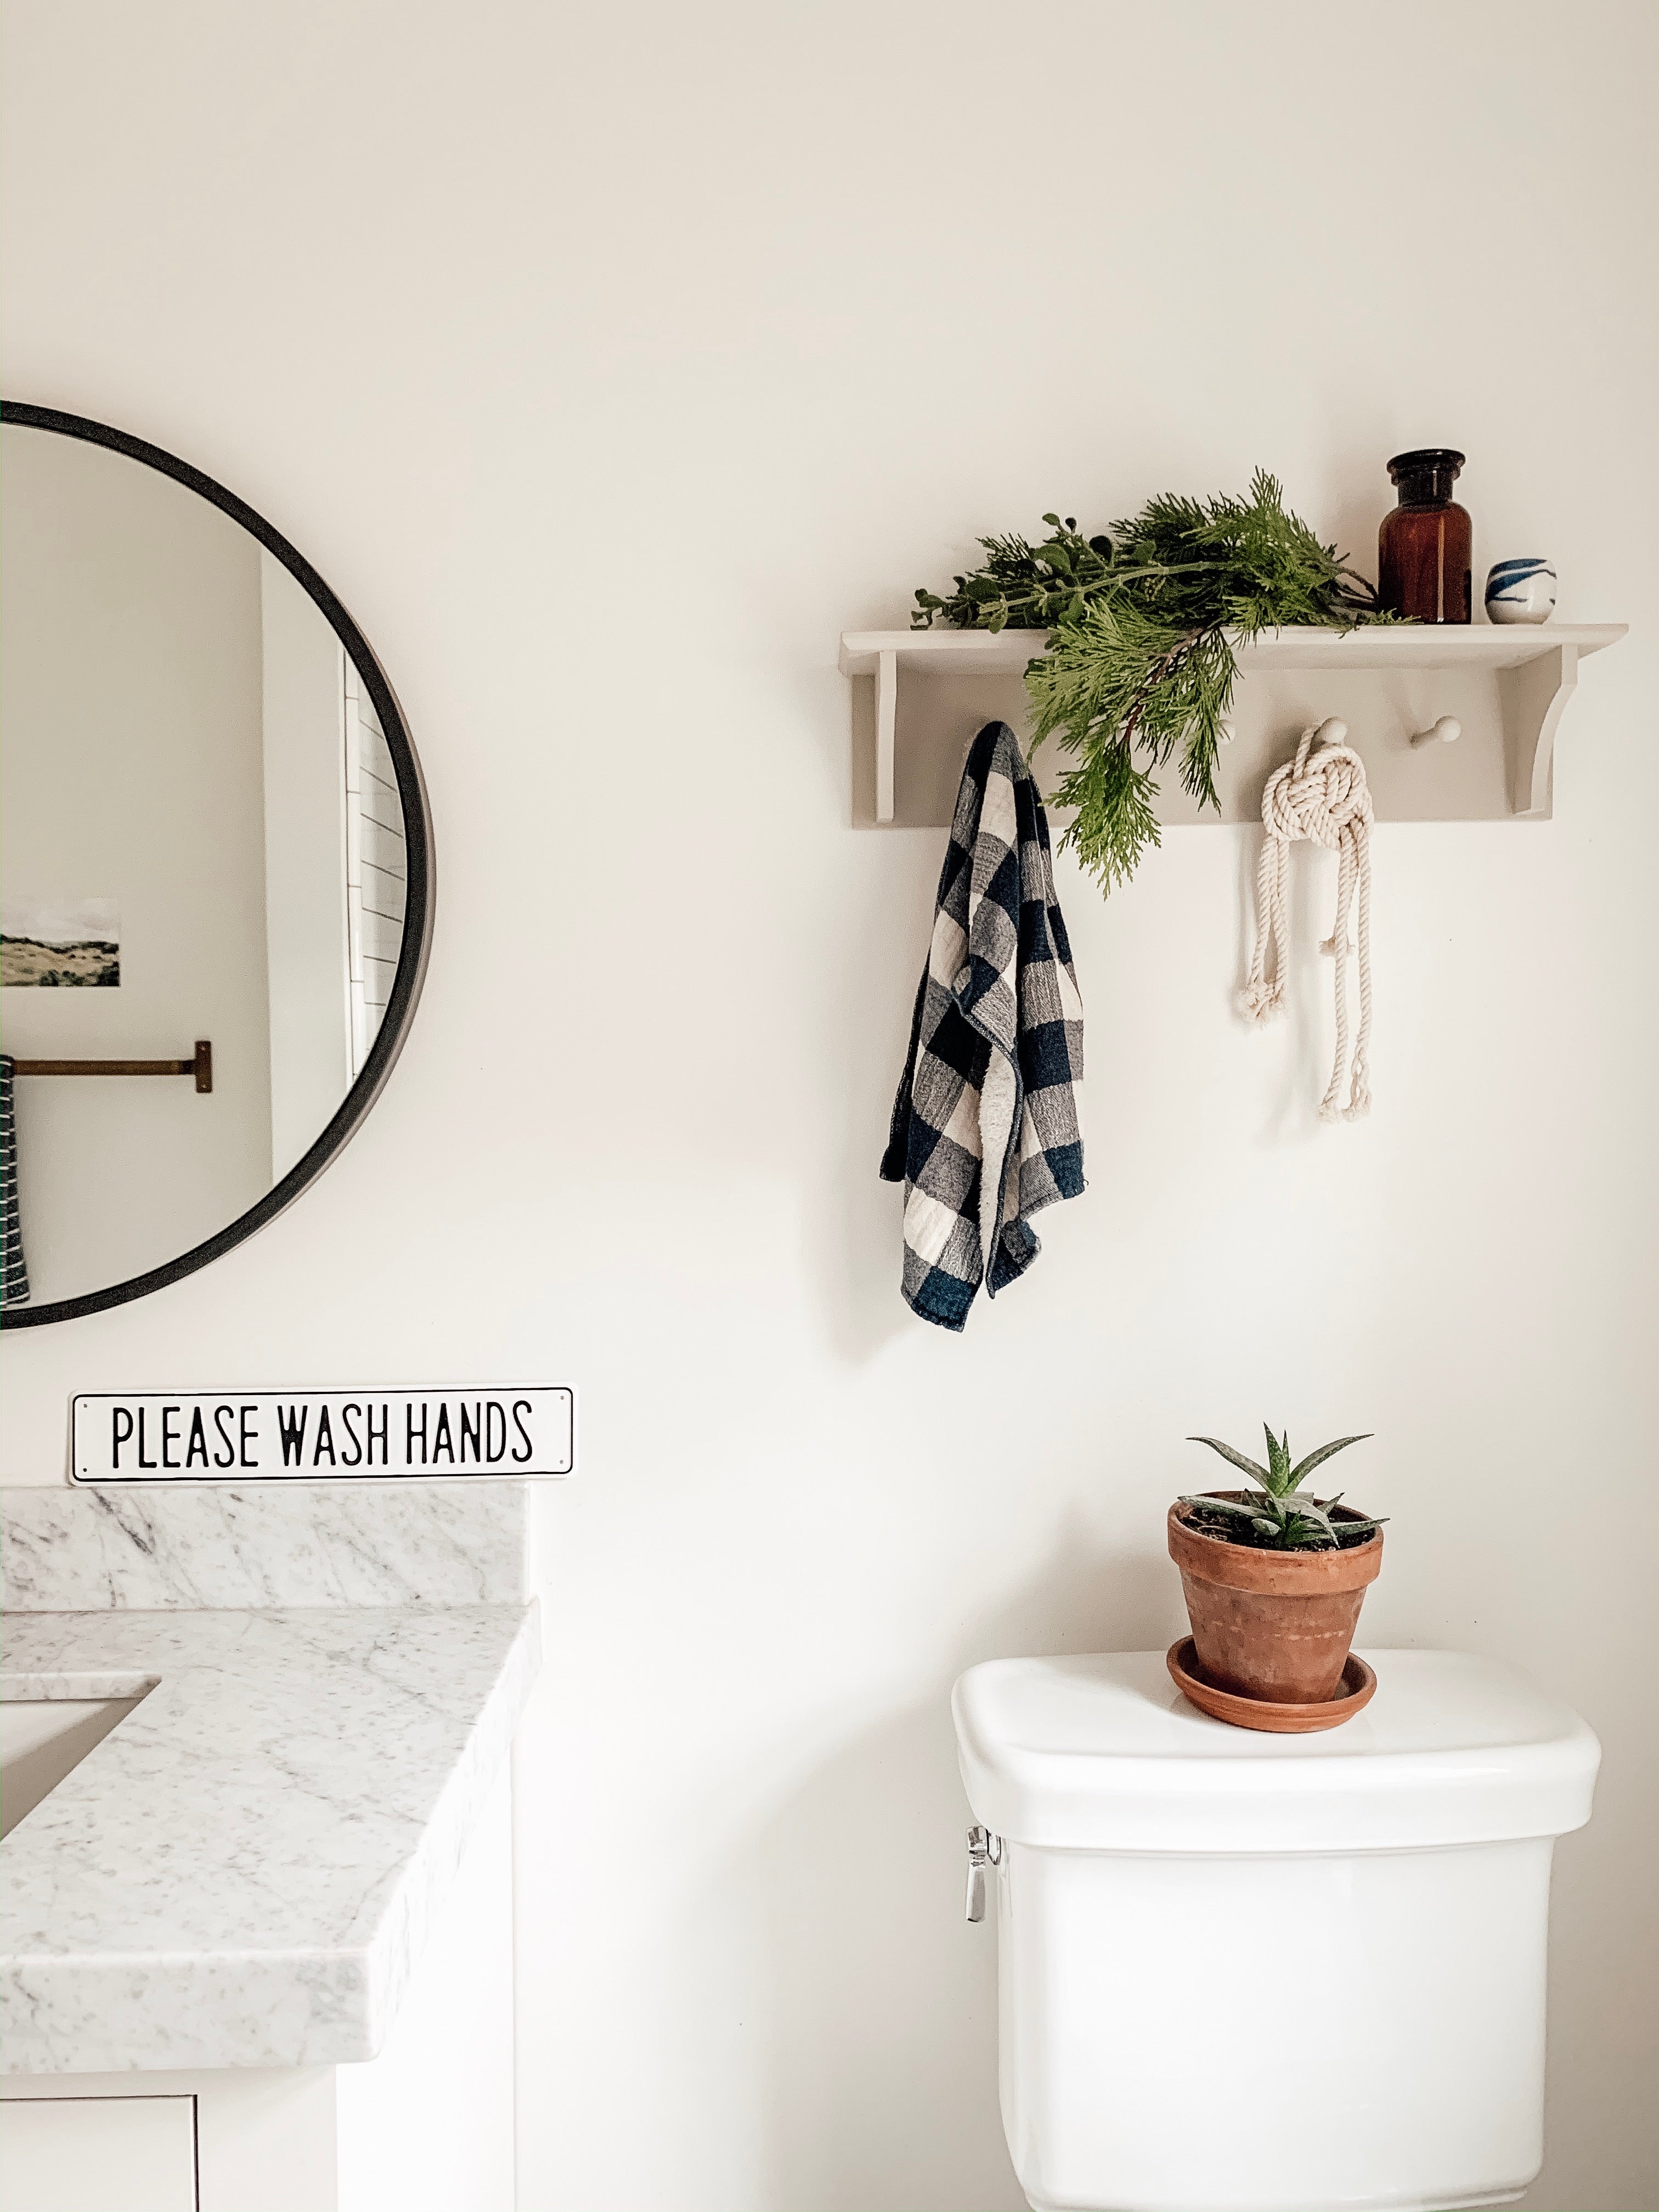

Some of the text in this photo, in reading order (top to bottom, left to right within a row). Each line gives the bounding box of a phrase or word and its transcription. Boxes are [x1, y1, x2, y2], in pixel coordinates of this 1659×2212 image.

[112, 1400, 533, 1469] PLEASE WASH HANDS
